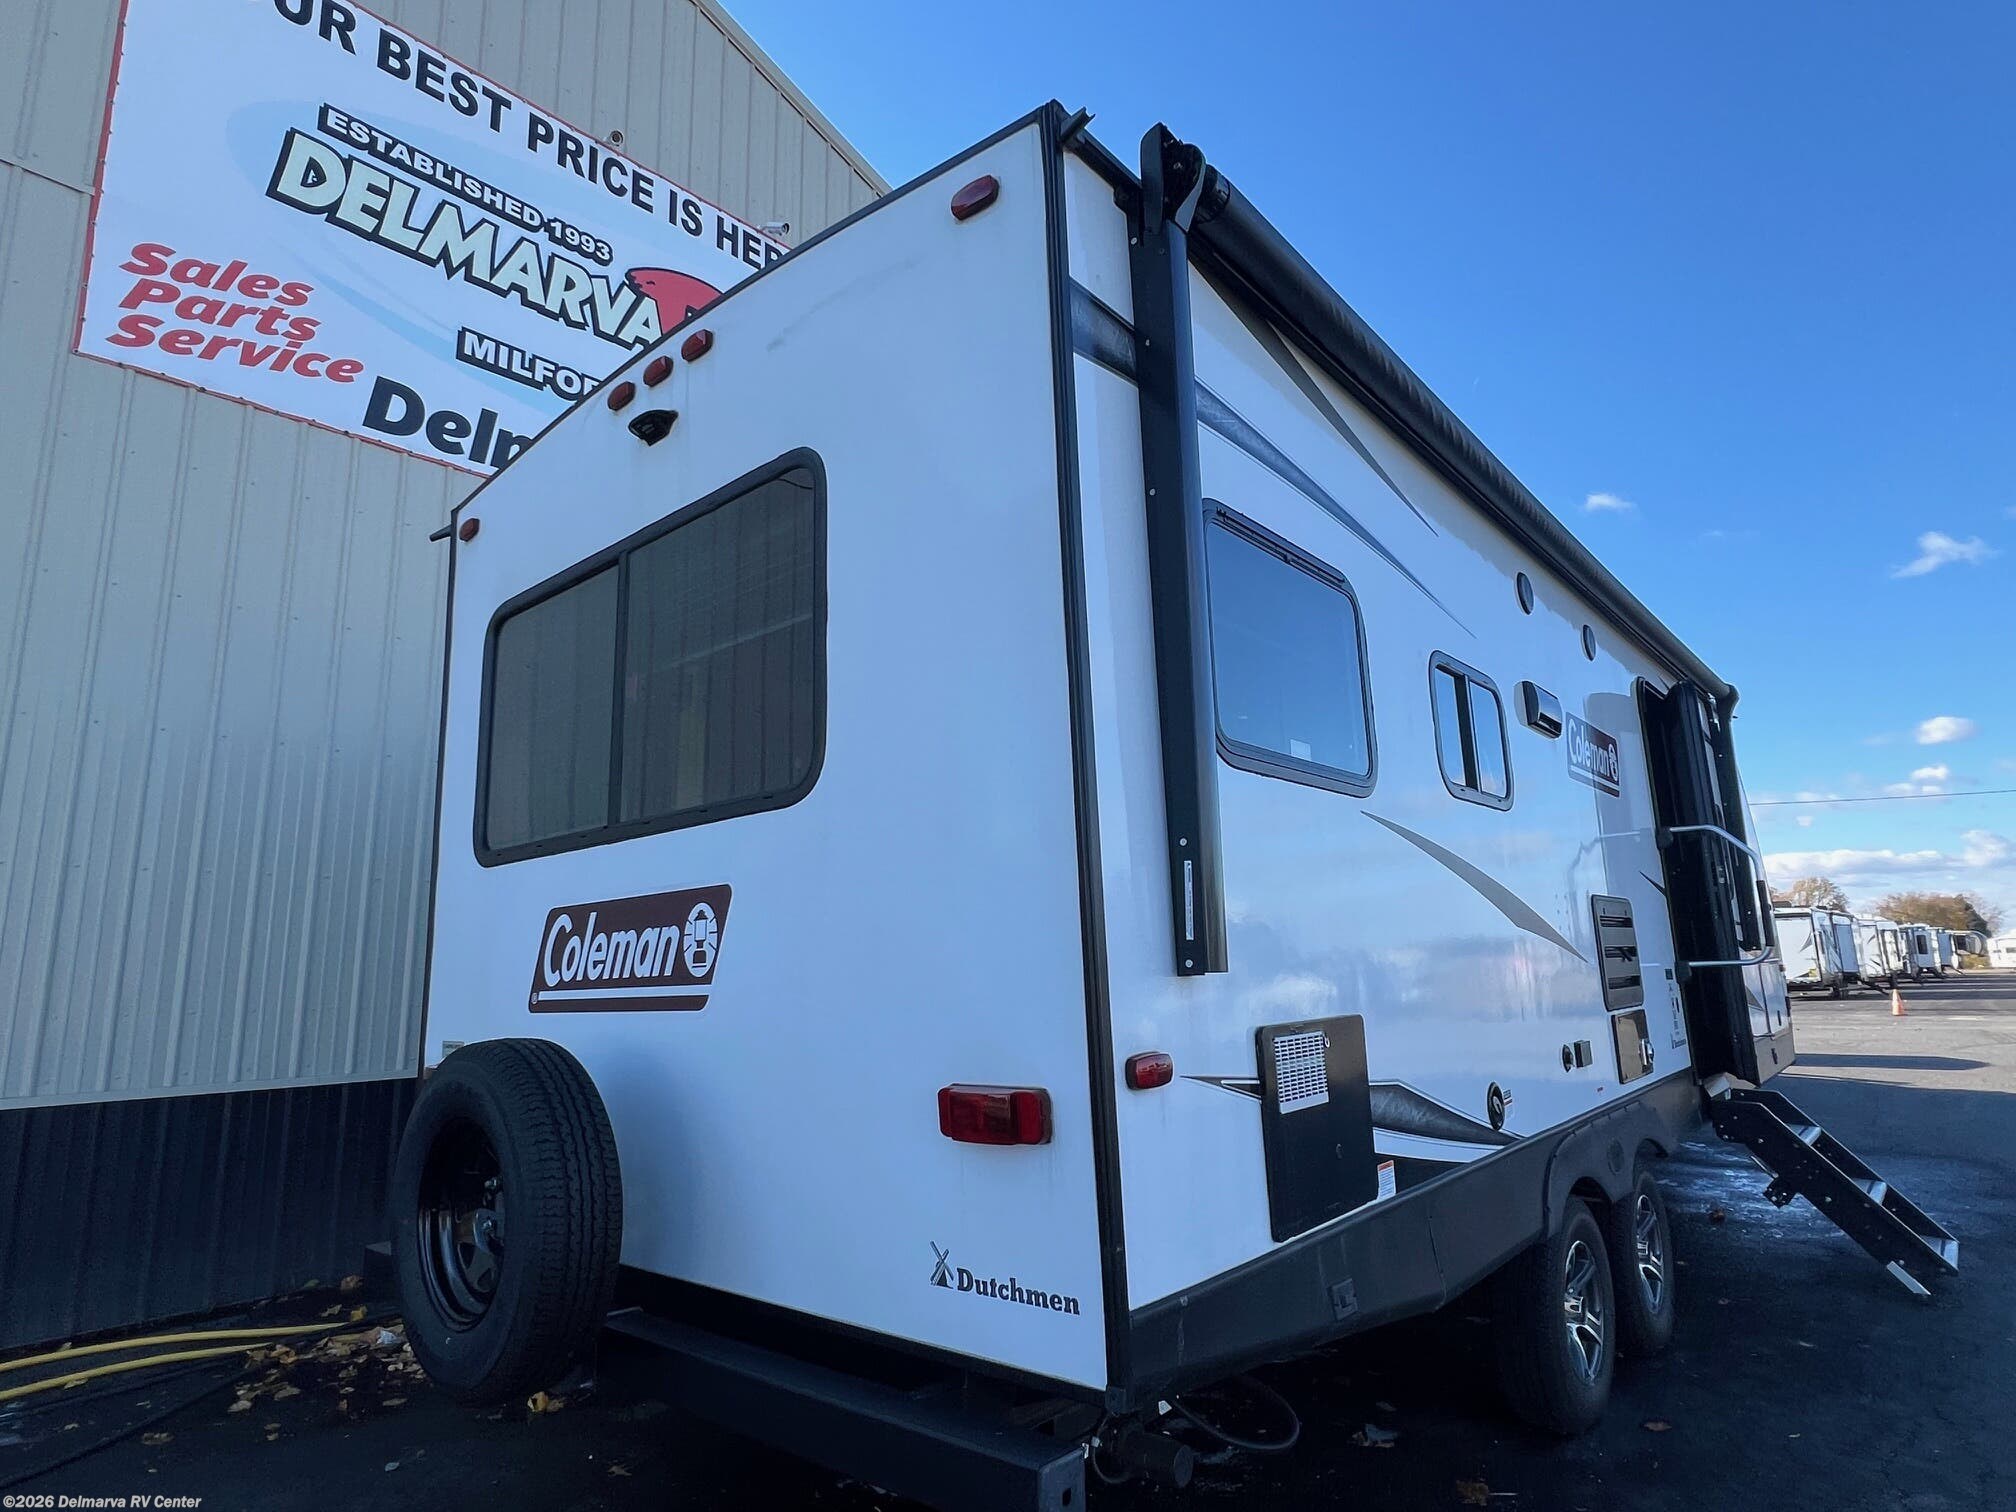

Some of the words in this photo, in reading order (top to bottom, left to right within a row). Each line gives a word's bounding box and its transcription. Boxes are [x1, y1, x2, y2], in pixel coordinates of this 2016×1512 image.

[377, 28, 512, 133] BEST
[527, 112, 654, 214] PRICE
[668, 188, 703, 236] IS
[326, 108, 542, 228] ESTABLISHED
[550, 218, 612, 263] 1993
[270, 128, 664, 349] DELMARVA
[119, 243, 314, 306] Sales
[118, 278, 322, 341] Parts
[105, 314, 364, 383] Service
[1568, 718, 1610, 776] Coleman
[544, 911, 680, 988] Coleman
[956, 1267, 1080, 1316] Dutchmen
